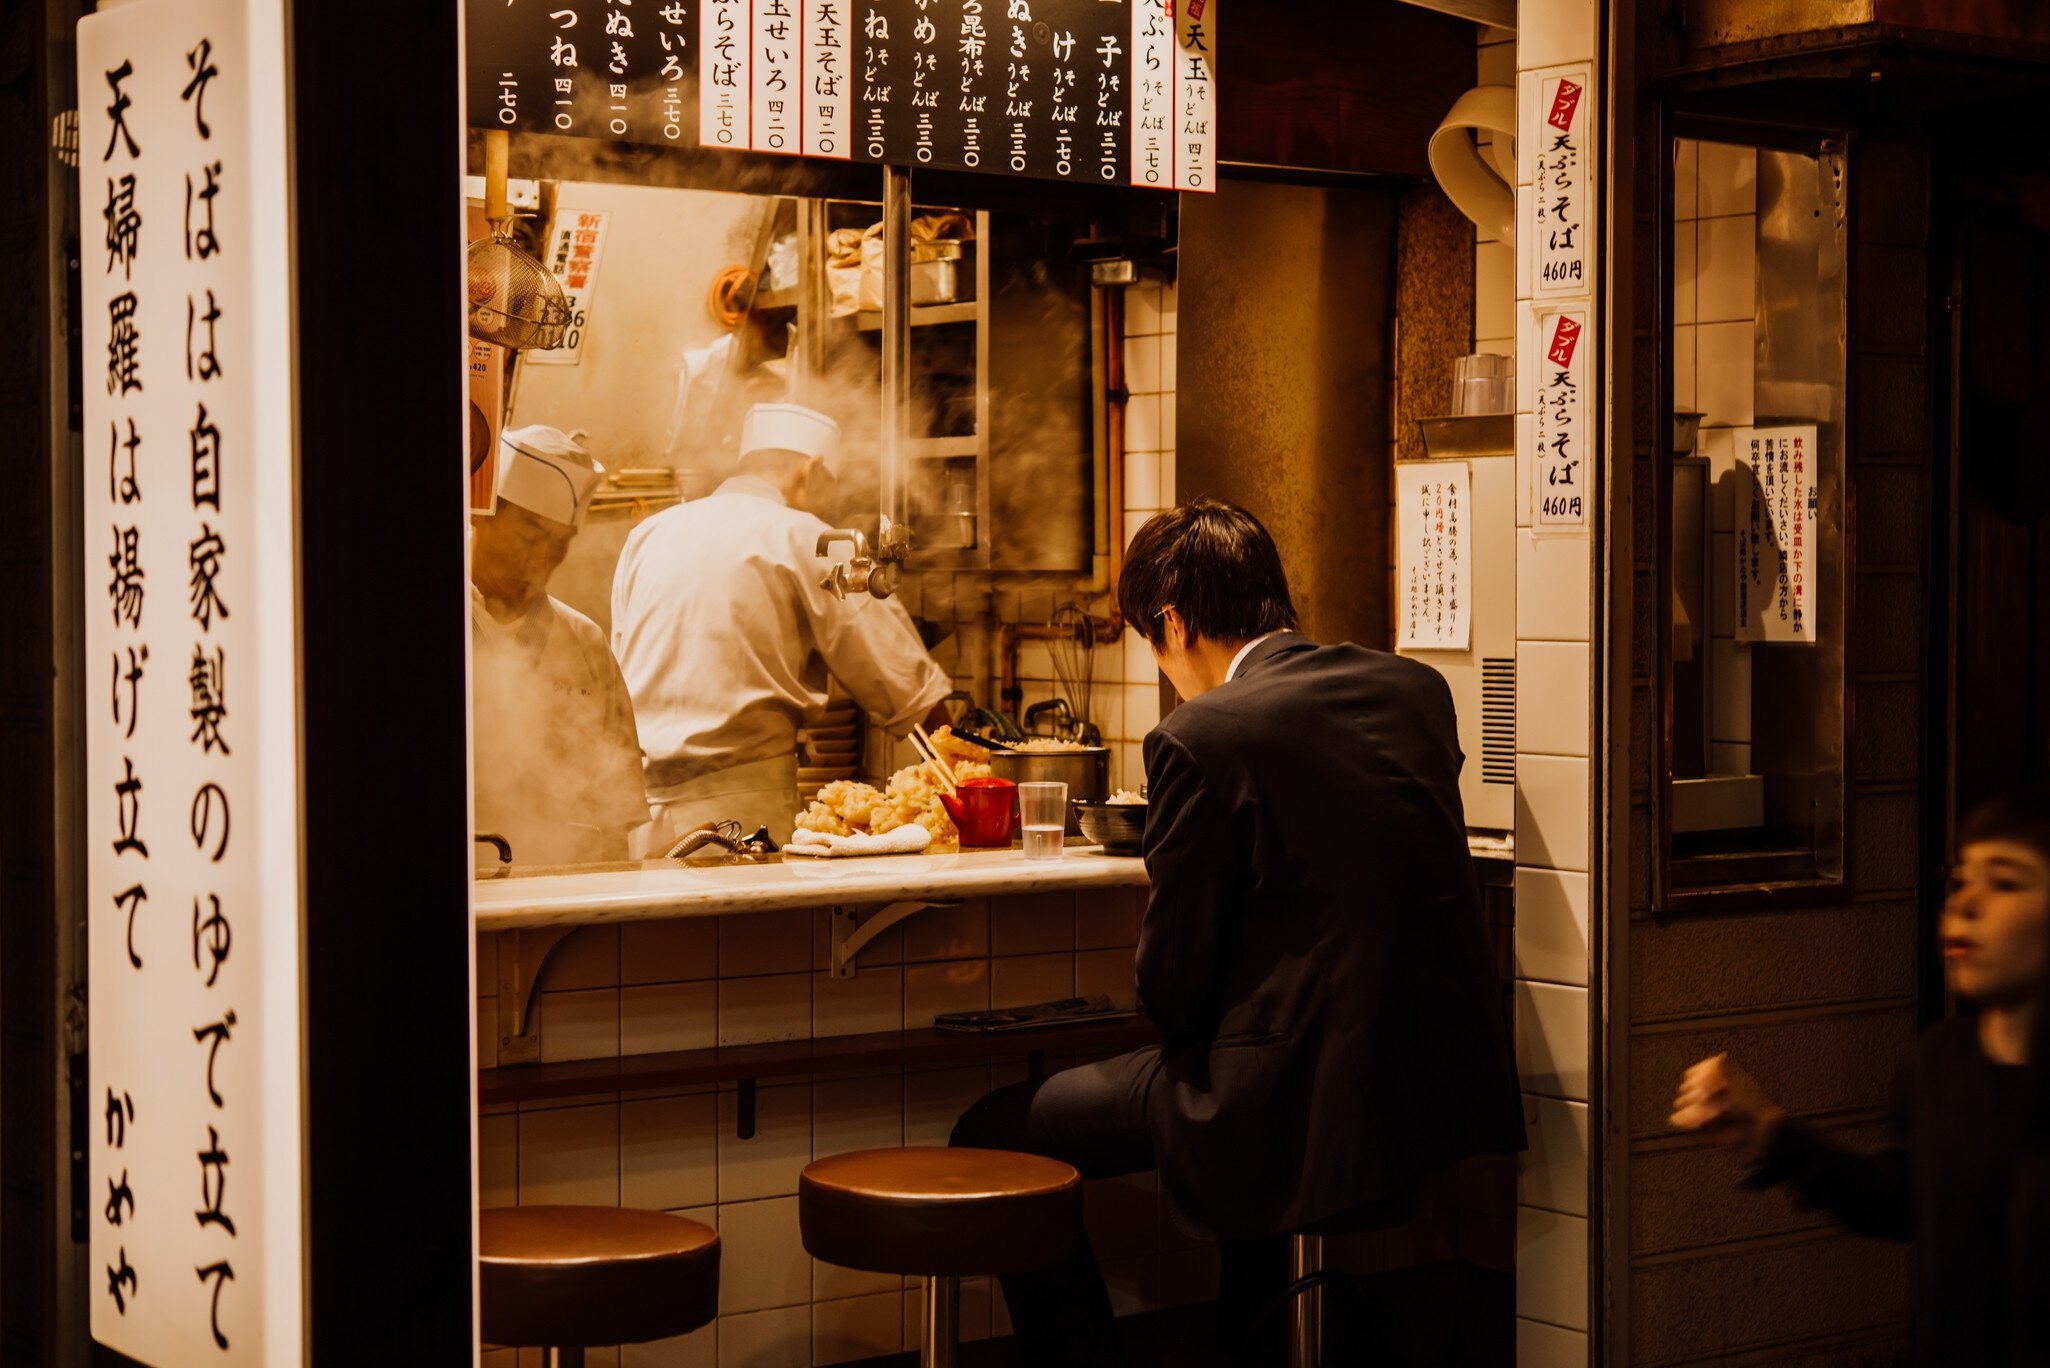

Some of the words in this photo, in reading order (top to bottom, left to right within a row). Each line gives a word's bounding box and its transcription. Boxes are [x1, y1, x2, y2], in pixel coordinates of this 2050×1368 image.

[659, 2, 686, 85] せいろ
[713, 0, 741, 87] らそば
[864, 0, 890, 39] ね
[1096, 0, 1122, 67] 子
[814, 4, 842, 96] 天玉そば
[864, 47, 877, 101] うどん
[1184, 24, 1209, 81] 天玉
[499, 73, 517, 124] 二七〇
[876, 49, 891, 102] そば
[912, 52, 924, 106] うどん
[924, 55, 939, 107] そば
[960, 55, 972, 111] うどん
[971, 57, 986, 112] そば
[1006, 63, 1018, 116] うどん
[1017, 65, 1032, 117] そば
[1052, 68, 1064, 121] うどん
[1063, 70, 1078, 122] そば
[1097, 73, 1108, 125] うどん
[555, 79, 572, 129] 四一〇
[610, 84, 627, 134] 四一〇
[663, 88, 681, 139] 三七〇
[717, 94, 733, 143] 三七〇
[769, 101, 784, 148] 四二〇
[1107, 76, 1122, 126] そば
[1141, 80, 1152, 129] うどん
[1153, 82, 1165, 130] そば
[1184, 85, 1197, 133] うどん
[1196, 86, 1208, 134] そば
[1551, 85, 1579, 125] ダブル
[819, 106, 835, 152] 四二〇
[868, 109, 884, 158] 三三〇
[917, 114, 932, 162] 三三〇
[964, 118, 980, 166] 三三〇
[1011, 123, 1026, 171] 三三〇
[1056, 129, 1071, 175] 二七〇
[1101, 132, 1116, 179] 三二〇
[1145, 138, 1160, 183] 三七〇
[1187, 143, 1202, 187] 四二〇
[1549, 134, 1579, 250] 天ぷらそば
[1544, 260, 1581, 281] 460円
[1551, 321, 1580, 362] ダブル
[1550, 371, 1579, 485] 天ぷらそば
[103, 59, 148, 969] 天婦羅は揚げ立て
[1543, 497, 1581, 517] 460円
[1808, 485, 1817, 521] お願い
[181, 38, 237, 1351] そばは自家製のゆで立て
[105, 1087, 137, 1316] かめや
